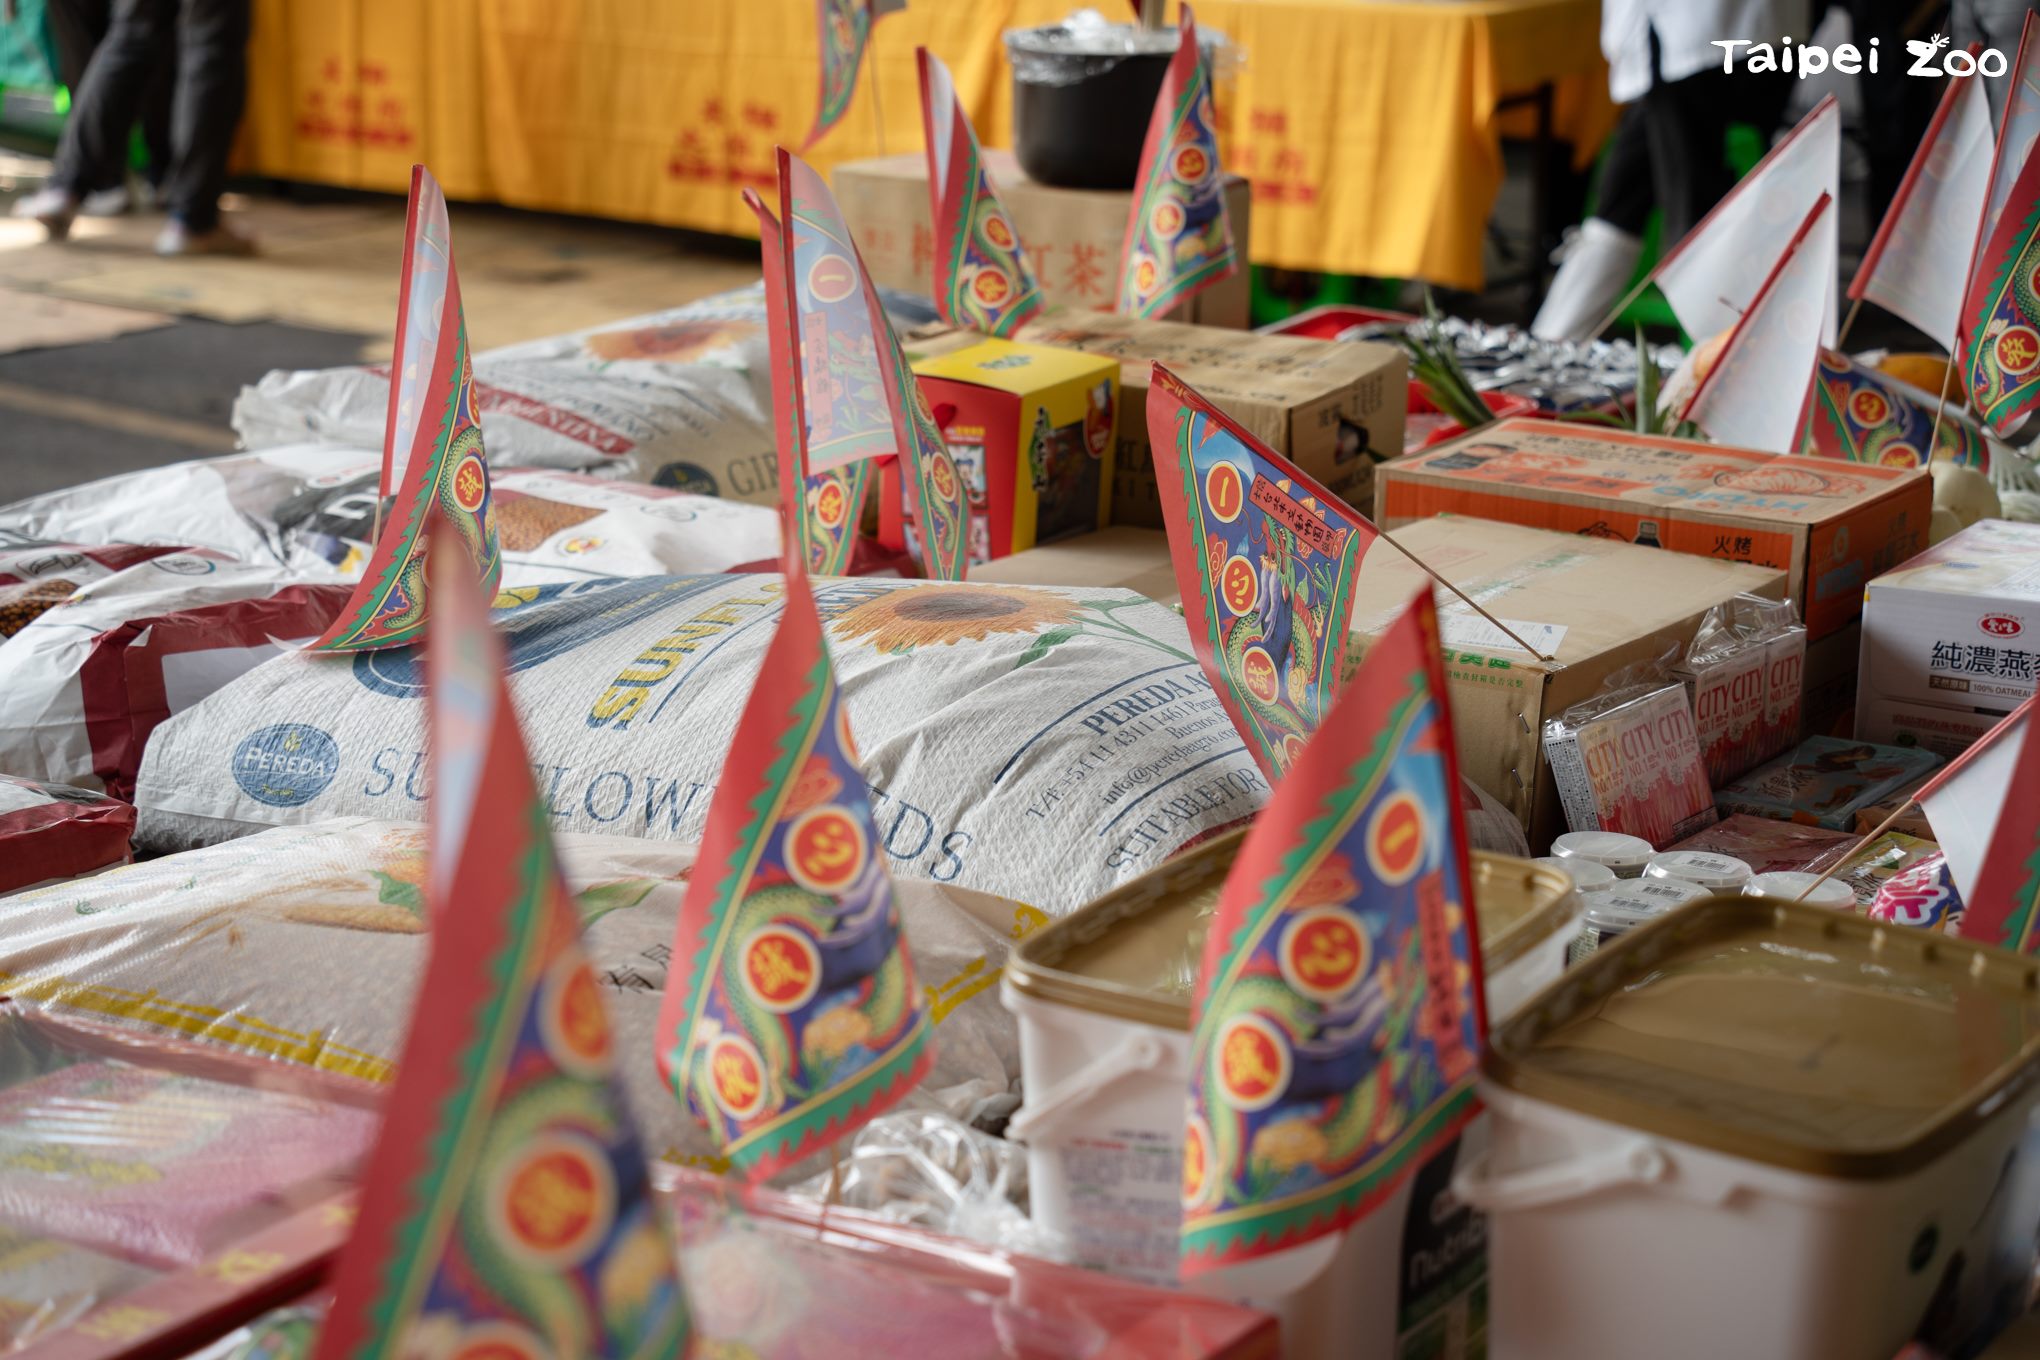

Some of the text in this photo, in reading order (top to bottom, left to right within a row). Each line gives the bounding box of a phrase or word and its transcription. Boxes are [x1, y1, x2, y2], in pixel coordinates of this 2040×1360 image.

[1711, 535, 1754, 557] 火烤
[586, 582, 787, 731] SUNFLO
[1771, 655, 1803, 689] CITY
[1930, 640, 2040, 679] 純濃燕
[1697, 679, 1731, 721] CITY
[1731, 665, 1764, 704] CITY
[1973, 683, 2032, 698] 100% OATMEAL
[1080, 679, 1194, 737] PEREDA
[1165, 714, 1218, 740] Buenos
[1658, 706, 1694, 747] CITY
[1586, 736, 1622, 779] CITY
[1621, 720, 1655, 762] CITY
[243, 746, 326, 777] PEREDA
[1106, 767, 1268, 873] SUITABLE FOR
